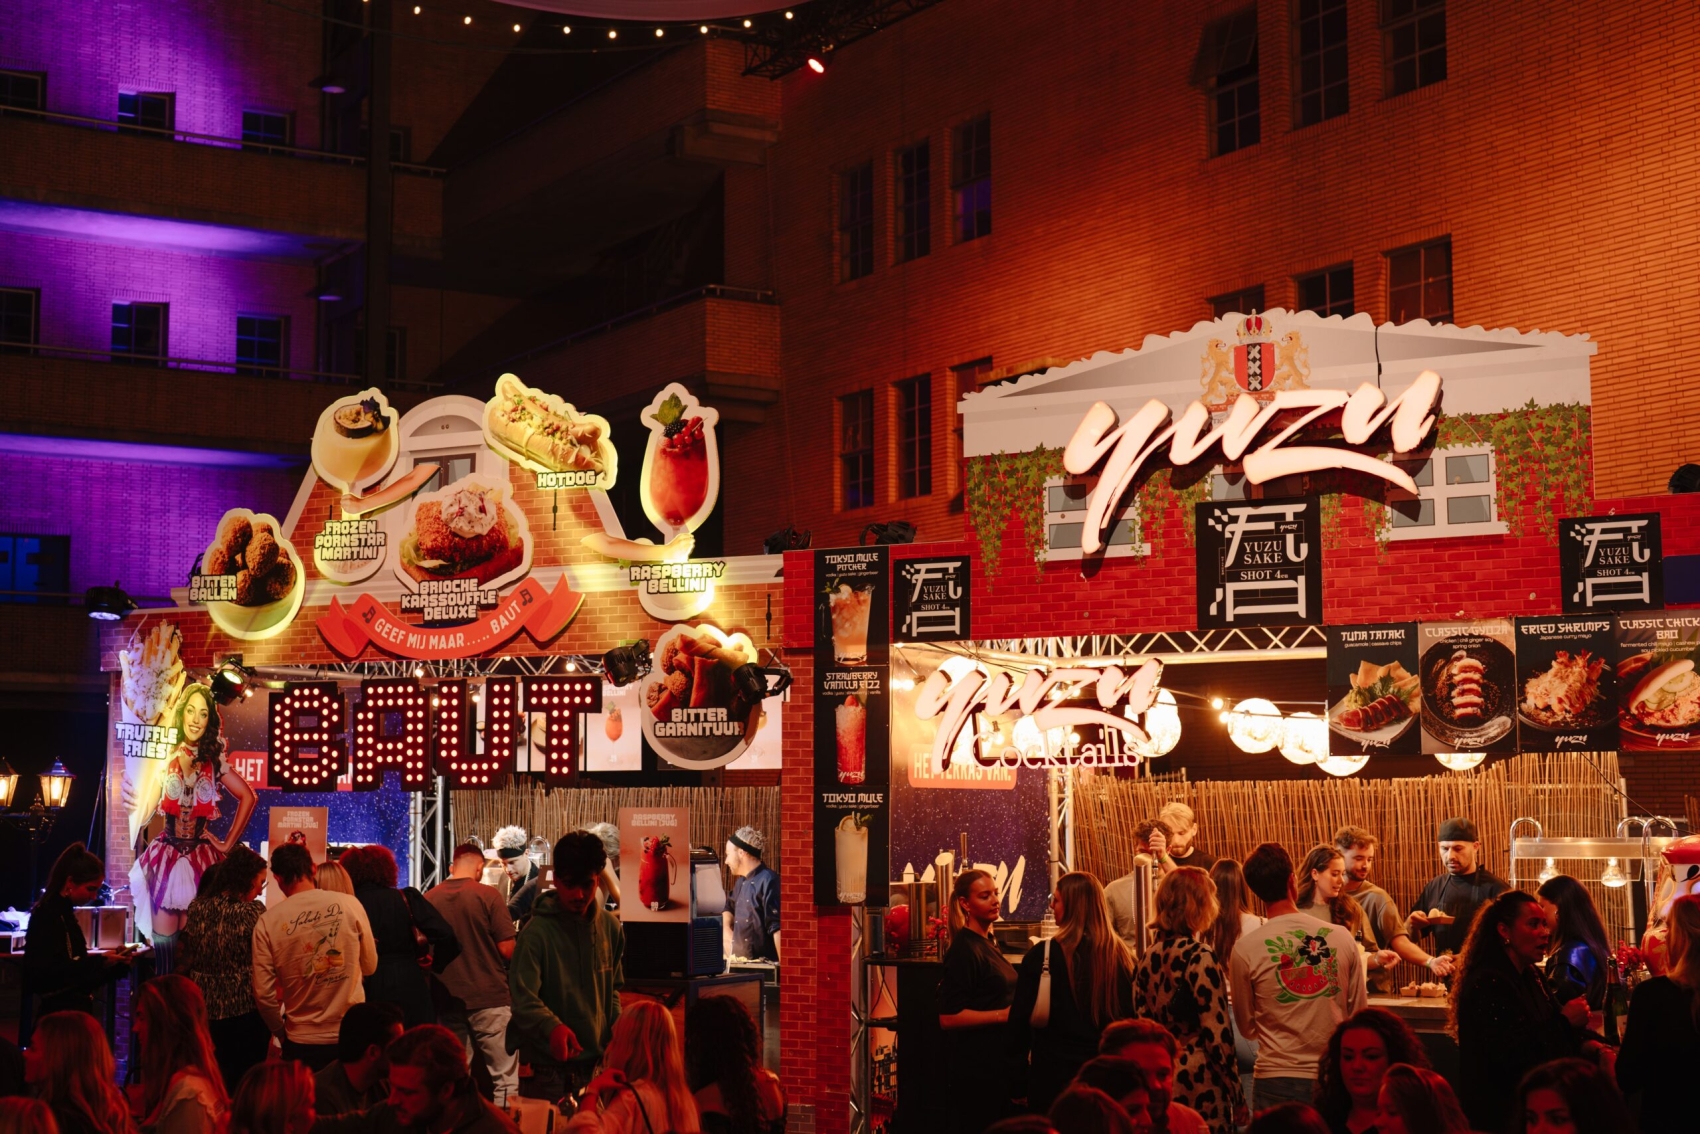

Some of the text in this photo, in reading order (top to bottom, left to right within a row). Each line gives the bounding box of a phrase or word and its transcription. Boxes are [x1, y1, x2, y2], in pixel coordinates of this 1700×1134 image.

[537, 471, 595, 488] HOTDOG
[325, 521, 377, 534] FROZEN
[315, 533, 385, 547] PORNSTAR
[320, 546, 377, 560] MARTINI
[1244, 541, 1282, 553] YUZU
[1599, 547, 1630, 556] YUZU
[825, 552, 879, 564] TOKYO MULE
[1244, 553, 1283, 565] SAKE
[1599, 556, 1630, 565] SAKE
[630, 562, 725, 581] RASPBERRY
[837, 563, 867, 571] PITCHER
[191, 575, 236, 588] BITTER
[1240, 570, 1272, 580] SHOT
[420, 579, 478, 594] BRIOCHE
[648, 578, 706, 594] BELLINI
[923, 585, 947, 593] YUZU
[189, 588, 237, 601] BALLEN
[401, 590, 497, 608] KAASSOUFFLE
[424, 605, 477, 621] DELUXE
[374, 618, 405, 644] GEEF
[406, 633, 426, 649] MIJ
[490, 600, 522, 634] BAUT
[1521, 621, 1610, 634] FRIED SHRIMPS
[1619, 619, 1664, 629] CLASSIC
[1341, 629, 1405, 641] TUNA TATAKI
[1425, 625, 1508, 637] CLASSIC GYOZA
[1656, 630, 1679, 639] BAO
[826, 672, 878, 680] STRAWBERRY
[824, 680, 858, 690] VANILLA
[672, 708, 727, 722] BITTER
[115, 724, 178, 744] TRUFFLE
[268, 676, 602, 791] BAUT
[655, 722, 744, 736] GARNITUUR
[123, 740, 167, 759] FRIES
[970, 728, 1140, 770] Cocktails
[235, 758, 264, 782] HET
[822, 793, 884, 803] TOKYO MULE
